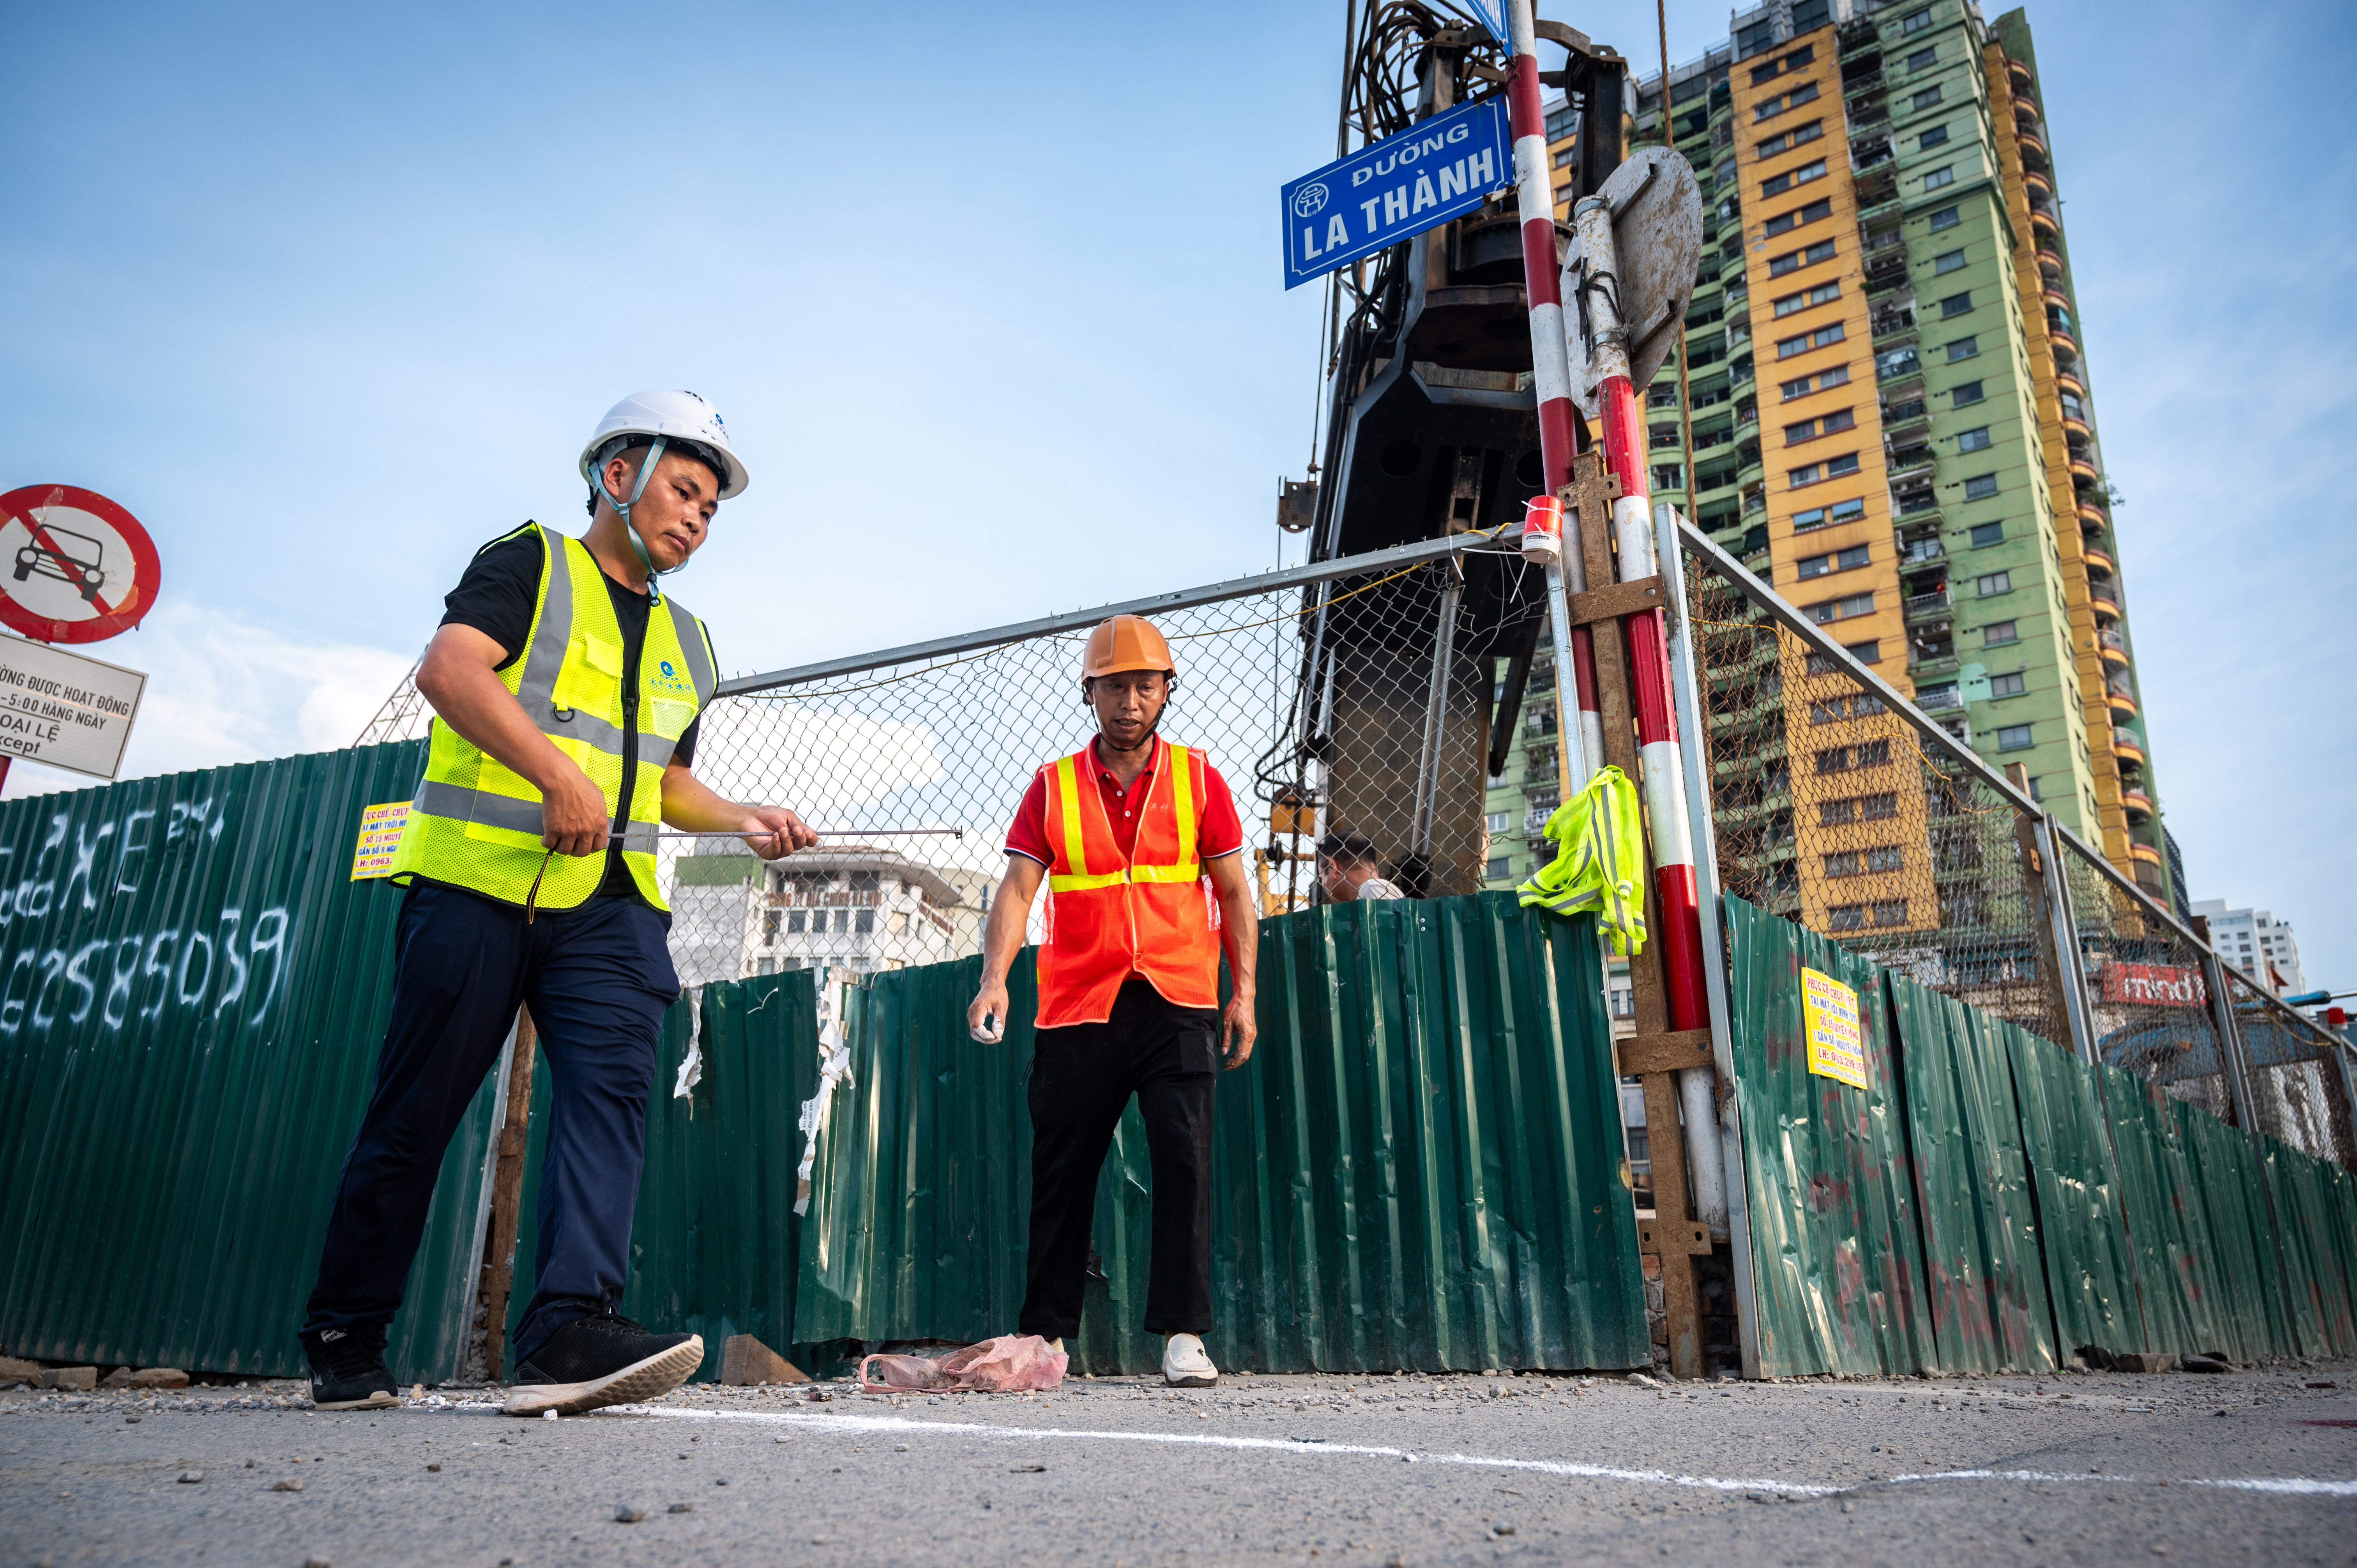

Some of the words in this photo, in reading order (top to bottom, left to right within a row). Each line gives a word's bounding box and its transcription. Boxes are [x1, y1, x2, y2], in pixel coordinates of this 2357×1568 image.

[1351, 123, 1469, 187] ĐƯỜNG
[1304, 213, 1349, 261] LA
[1360, 147, 1495, 234] THÀNH
[0, 664, 25, 686] ỜNG
[27, 676, 61, 696] ĐƯỢC
[63, 686, 95, 706] HOẠT
[97, 695, 129, 715] ĐỘNG
[41, 701, 73, 721] HÀNG
[75, 712, 107, 730] NGÀY
[35, 723, 60, 743] LỆ
[392, 807, 409, 817] CHỤP
[384, 819, 398, 828] TRỜI
[365, 833, 375, 844] SỐ
[371, 844, 381, 854] SỐ
[371, 857, 394, 865] 0963.
[1806, 977, 1822, 992] PHỤC
[1830, 988, 1843, 1003] CHỤP
[1810, 994, 1819, 1008] TẠI
[1820, 1014, 1827, 1027] SỐ
[1829, 1033, 1835, 1045] SỐ
[1818, 1048, 1829, 1059] LH:
